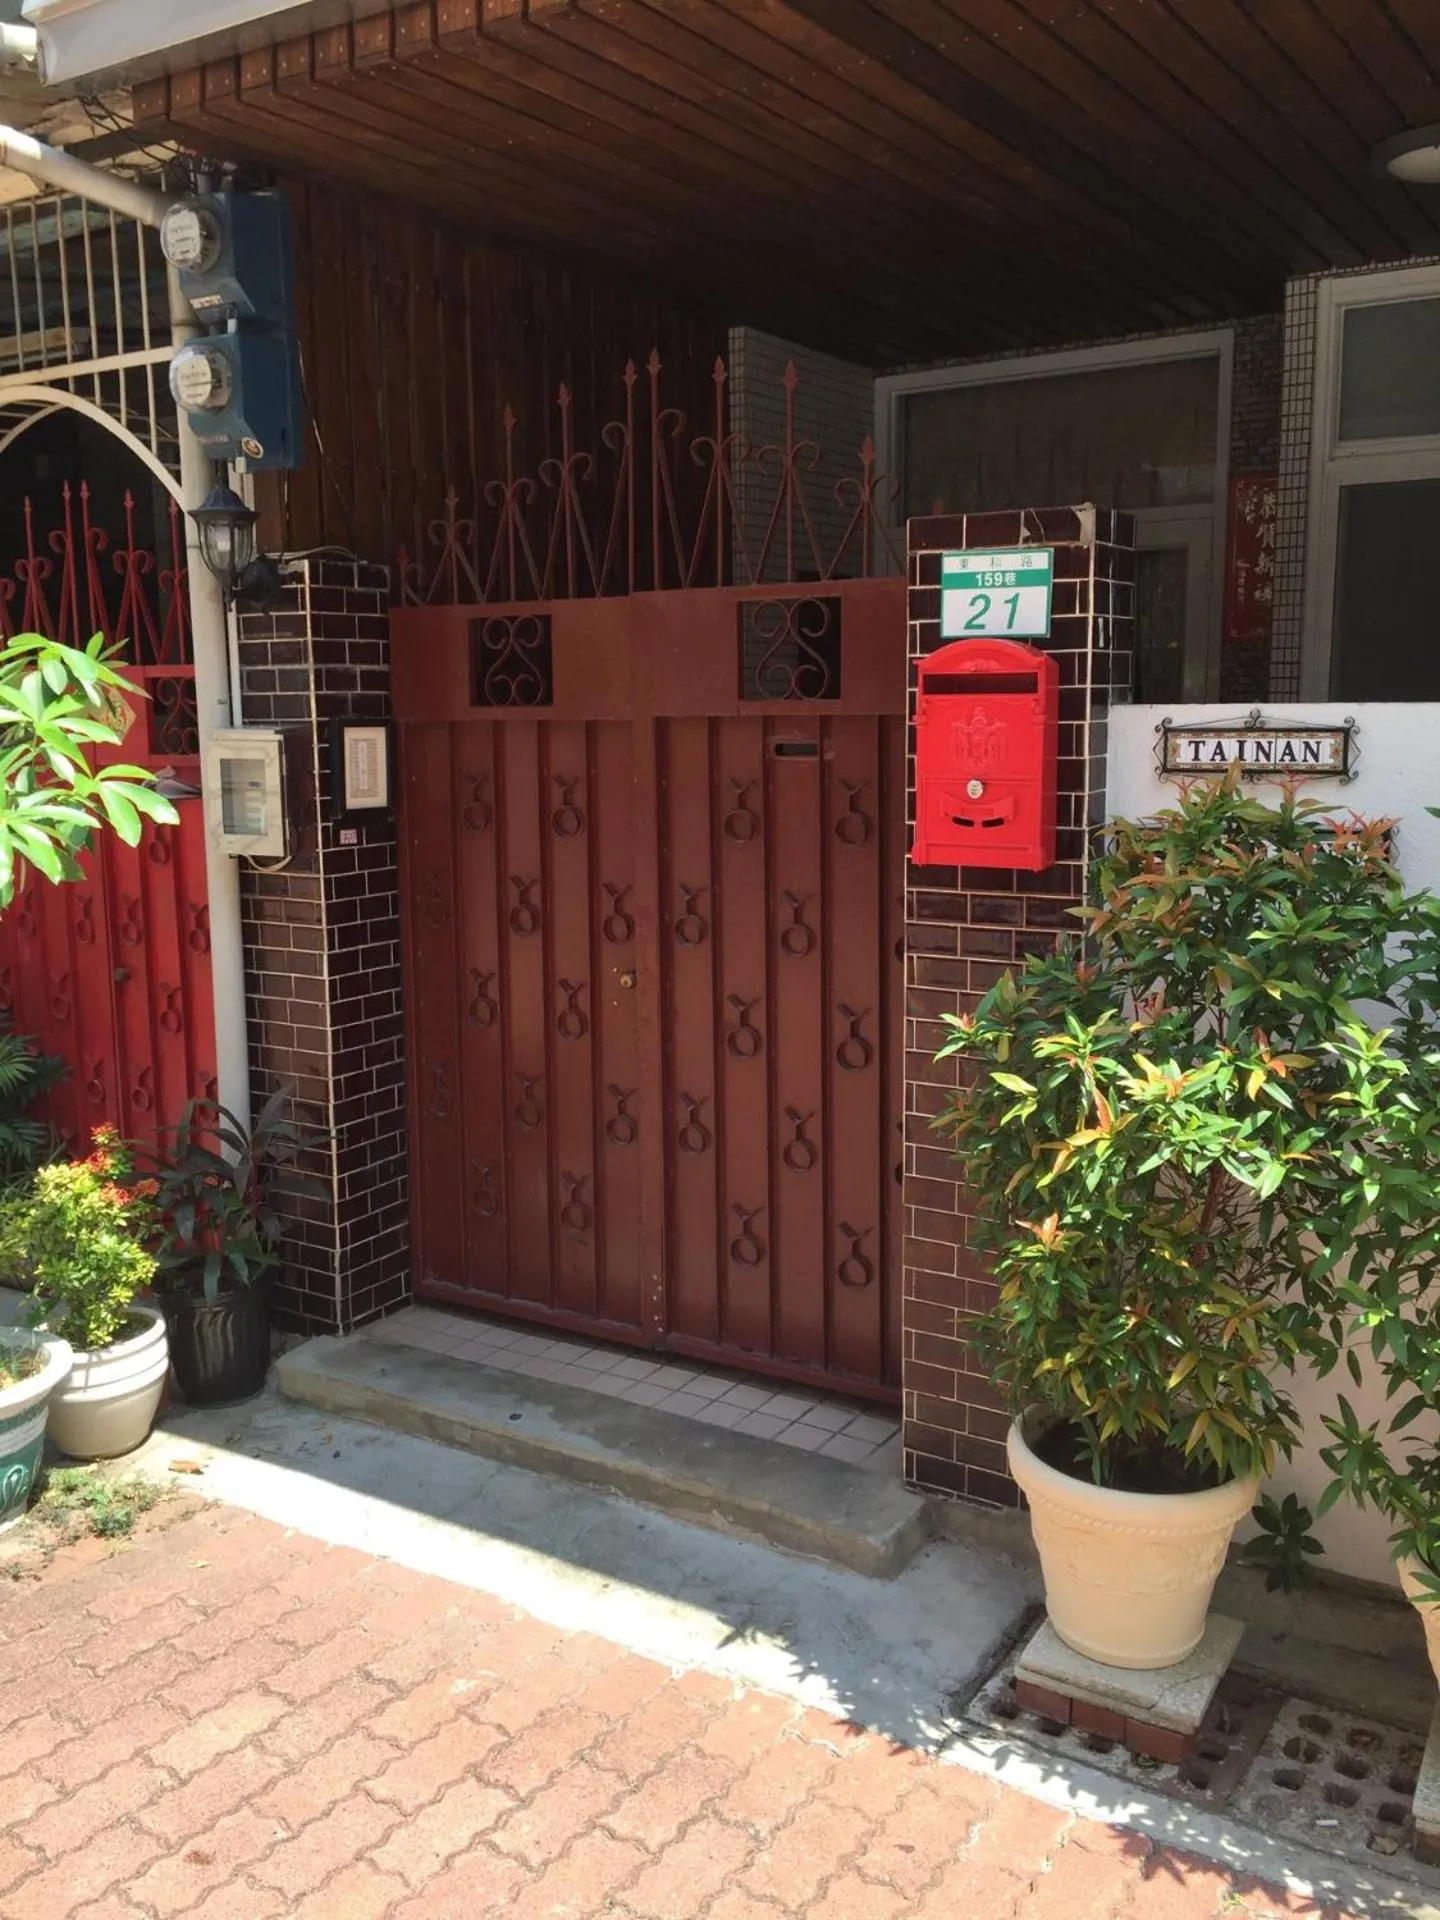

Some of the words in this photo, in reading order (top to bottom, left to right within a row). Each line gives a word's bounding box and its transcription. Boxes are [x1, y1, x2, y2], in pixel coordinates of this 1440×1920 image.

[976, 571, 1017, 587] 159巷
[964, 592, 1021, 630] 21
[1188, 739, 1323, 763] TAINAN
